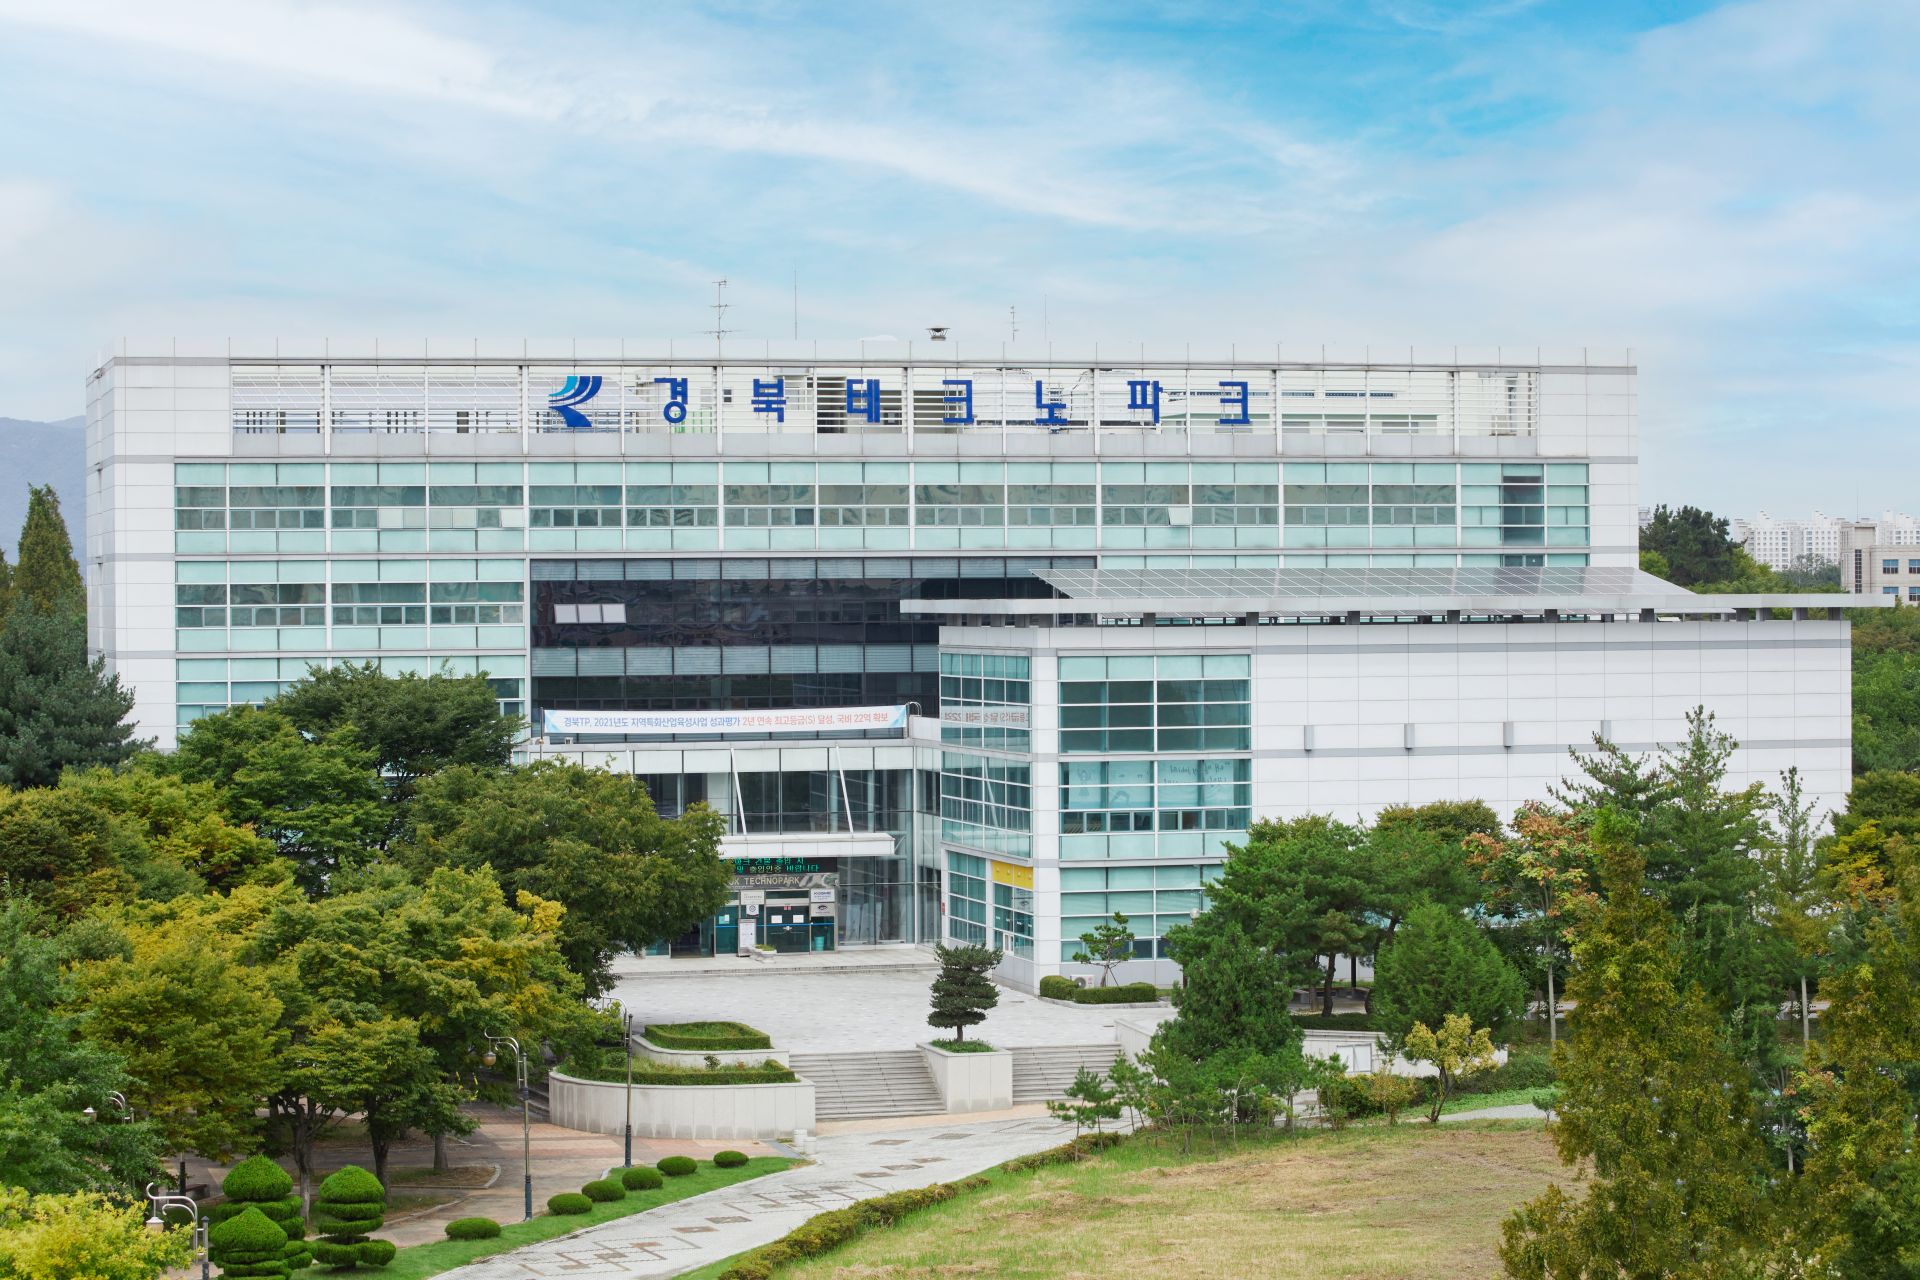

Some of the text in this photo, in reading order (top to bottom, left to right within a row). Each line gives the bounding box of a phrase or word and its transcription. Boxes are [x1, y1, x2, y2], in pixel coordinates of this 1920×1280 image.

[654, 377, 1249, 425] 경북테크노파크
[563, 717, 591, 728] 경북TP,
[594, 717, 629, 727] 2021년도
[631, 716, 708, 728] 지역특화산업육성사업
[710, 715, 740, 727] 성과평가
[743, 716, 755, 726] 2년
[757, 715, 772, 726] 연속
[774, 714, 815, 726] 최고등급(S)
[837, 713, 852, 724] 국비
[854, 713, 871, 723] 22억
[873, 712, 888, 722] 확보
[745, 876, 799, 885] TECHNOPARK
